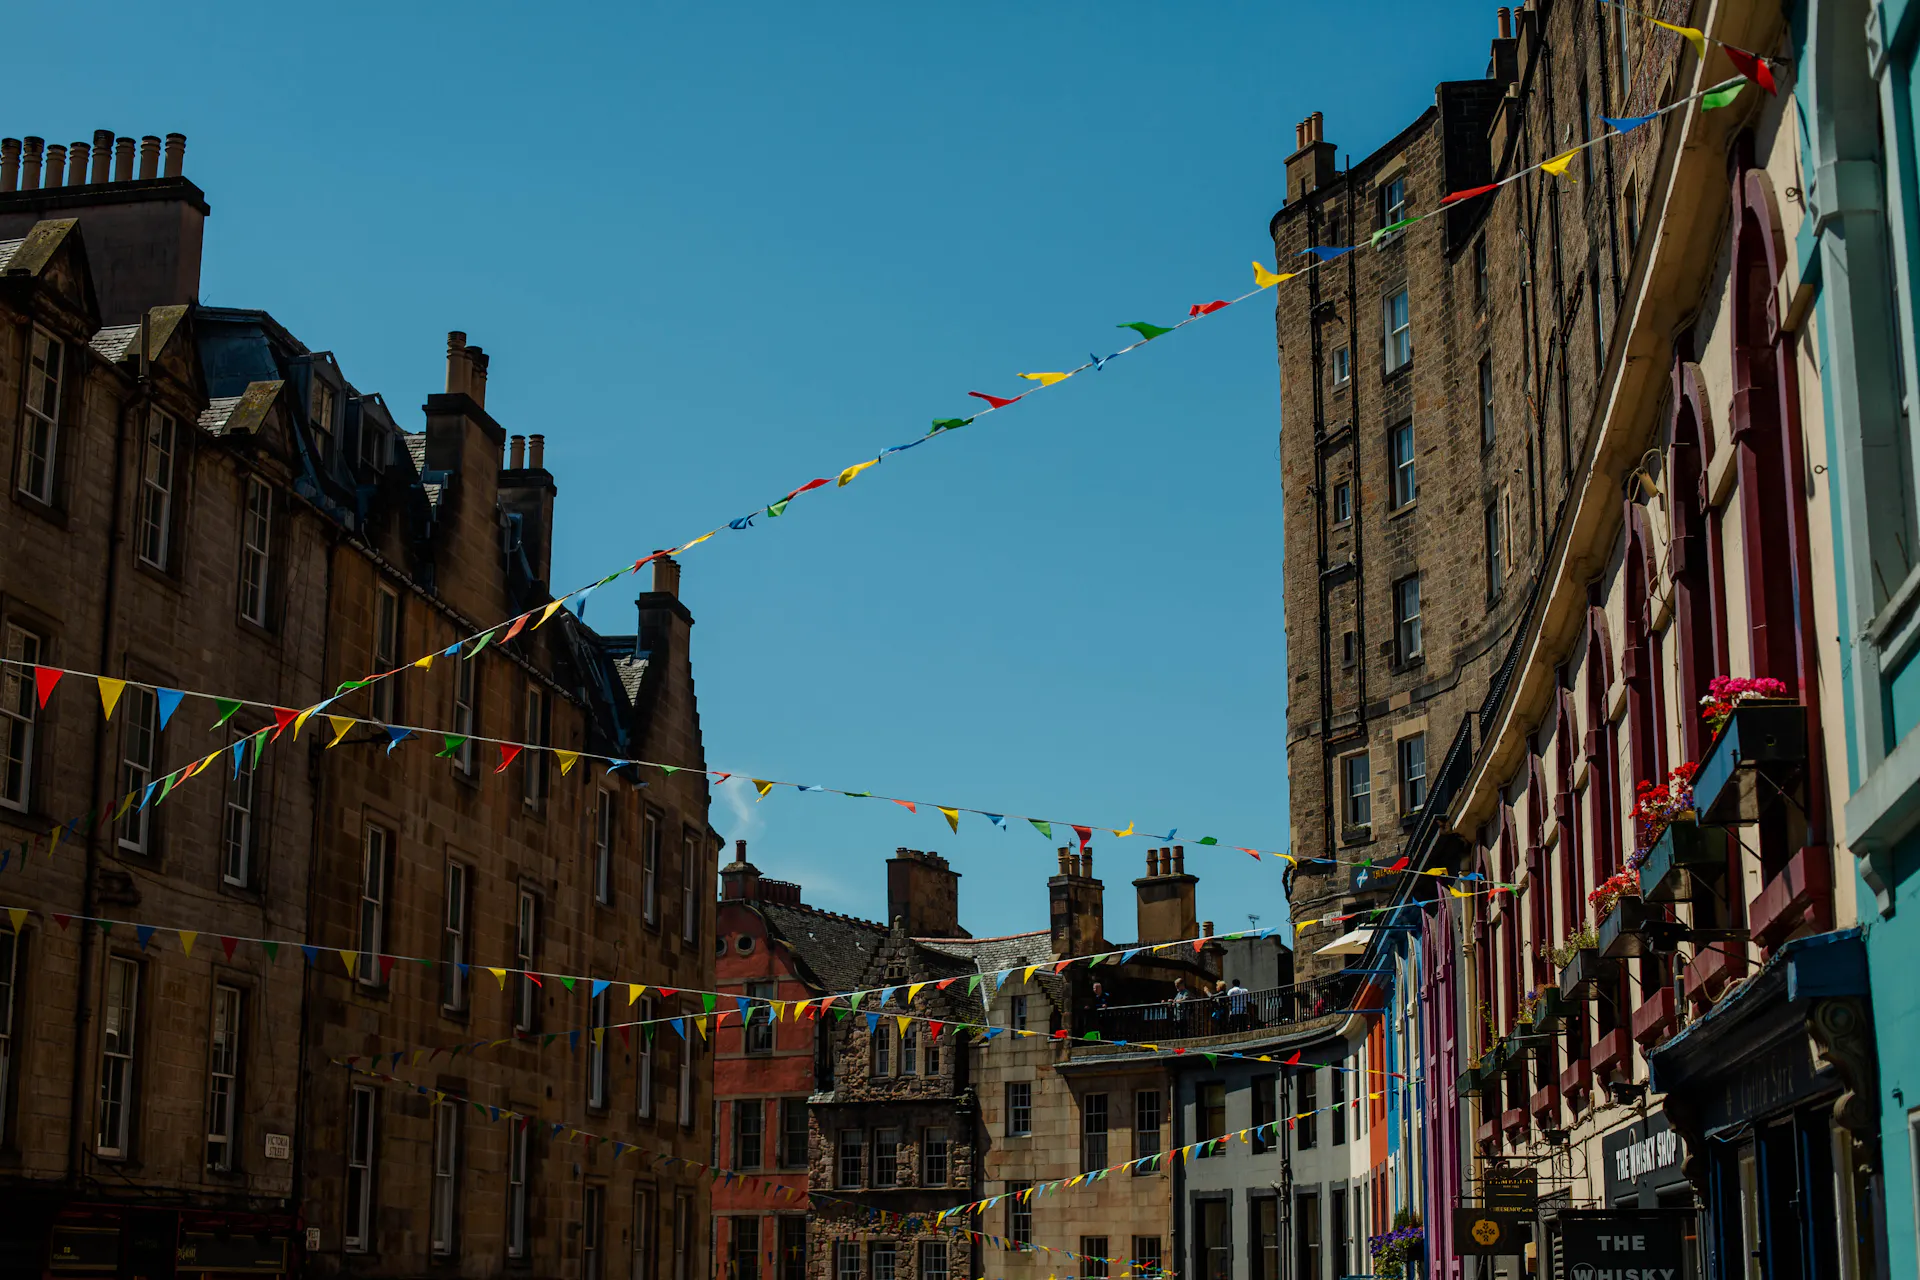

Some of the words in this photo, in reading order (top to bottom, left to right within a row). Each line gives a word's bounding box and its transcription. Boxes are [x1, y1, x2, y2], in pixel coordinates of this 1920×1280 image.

[269, 1146, 286, 1157] STREET
[1615, 1147, 1630, 1181] THE
[1628, 1134, 1656, 1178] WHISKY
[1656, 1128, 1677, 1168] SHOP
[1596, 1235, 1646, 1251] THE
[1570, 1267, 1675, 1280] WHISKY
